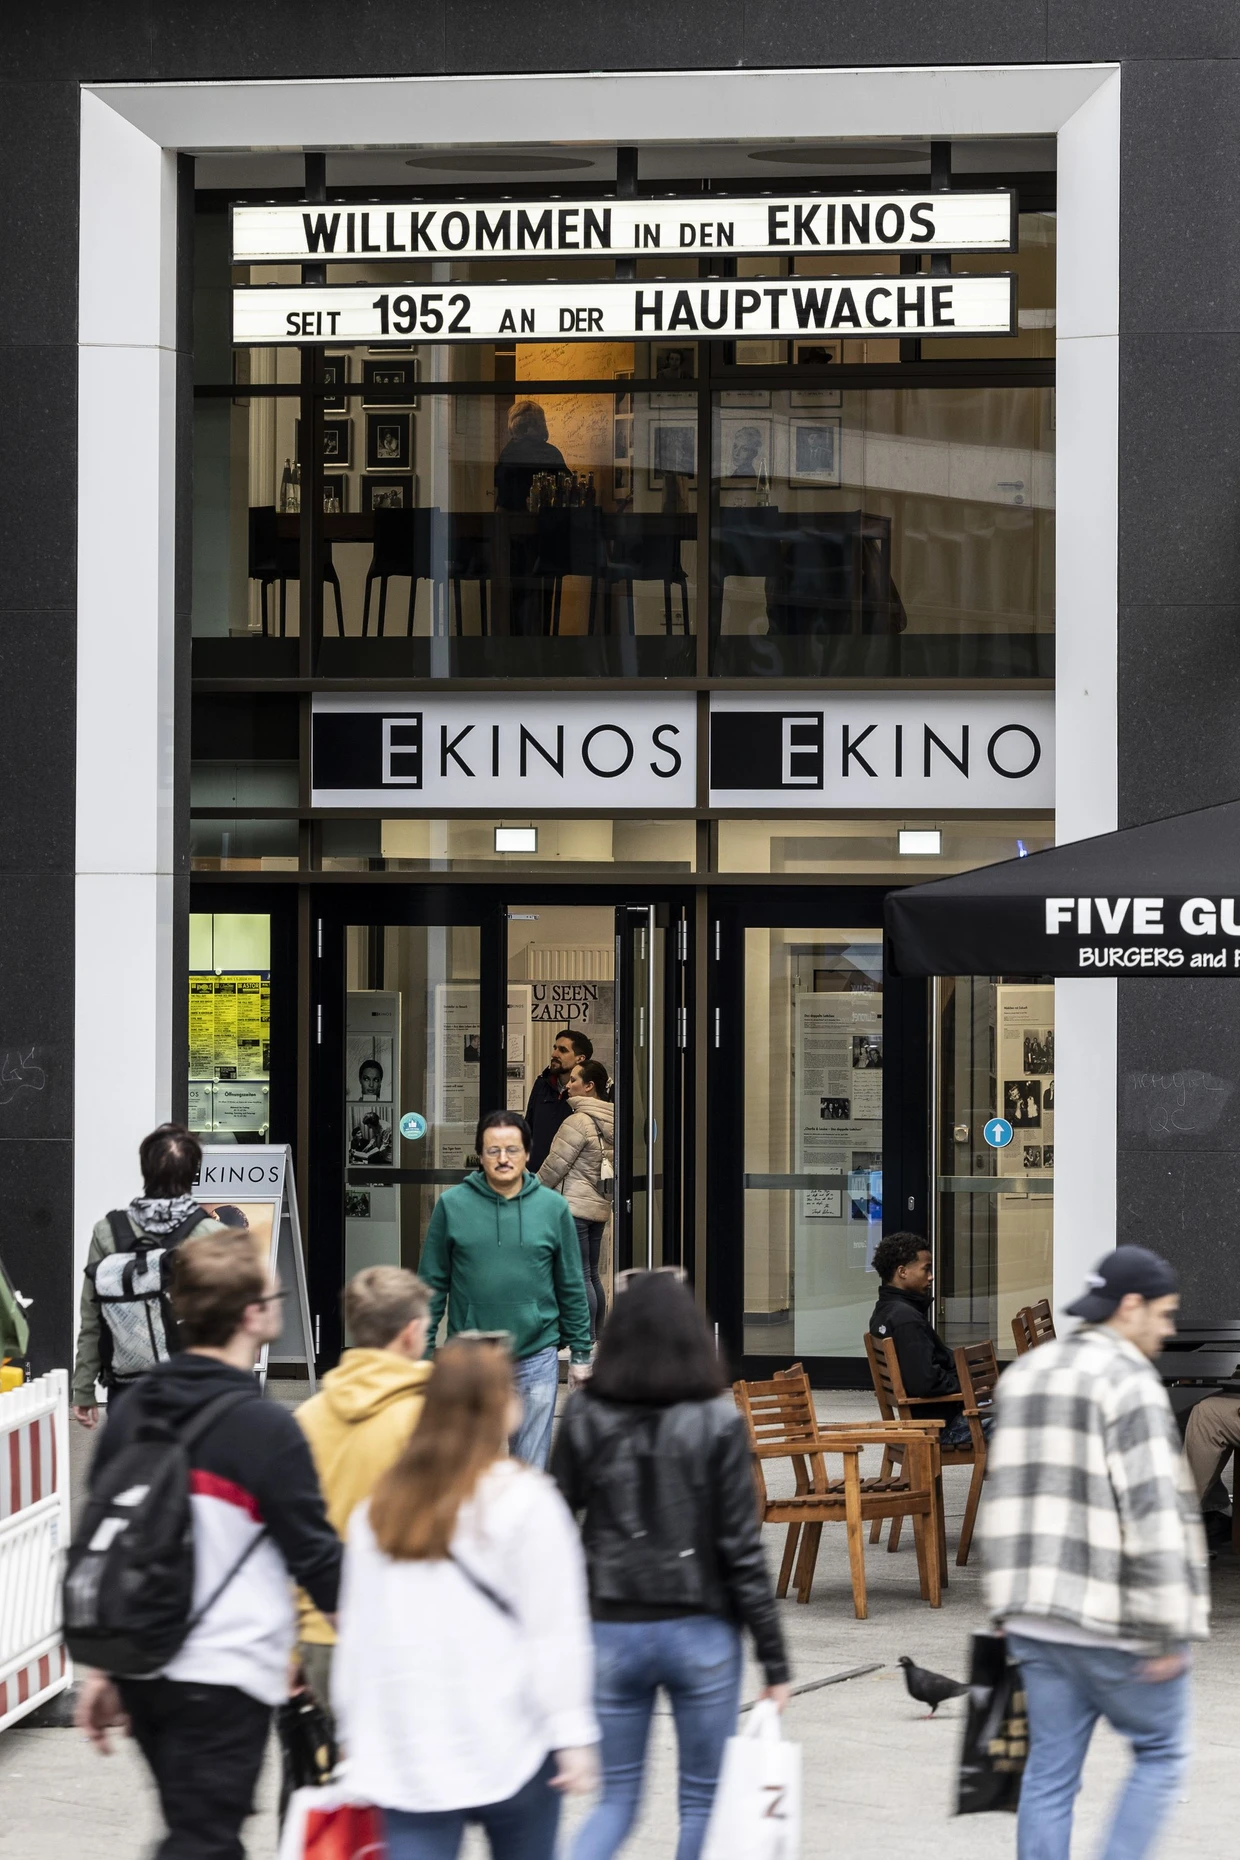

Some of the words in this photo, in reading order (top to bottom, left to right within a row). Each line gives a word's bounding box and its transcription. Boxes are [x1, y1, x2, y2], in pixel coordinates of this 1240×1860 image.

[302, 208, 612, 253] WILLKOMMEN
[634, 223, 661, 248] IN
[679, 222, 734, 248] DEN
[768, 202, 936, 245] EKINOS
[286, 311, 341, 336] SEIT
[372, 293, 471, 335] 1952
[498, 308, 535, 333] AN
[559, 307, 604, 333] DER
[634, 284, 955, 331] HAUPTWACHE
[382, 717, 682, 784] EKINOS
[1045, 897, 1164, 935] FIVE
[1078, 947, 1185, 968] BURGERS
[1189, 948, 1227, 968] and
[552, 984, 598, 1001] SEEN
[531, 1002, 589, 1023] ZARD?
